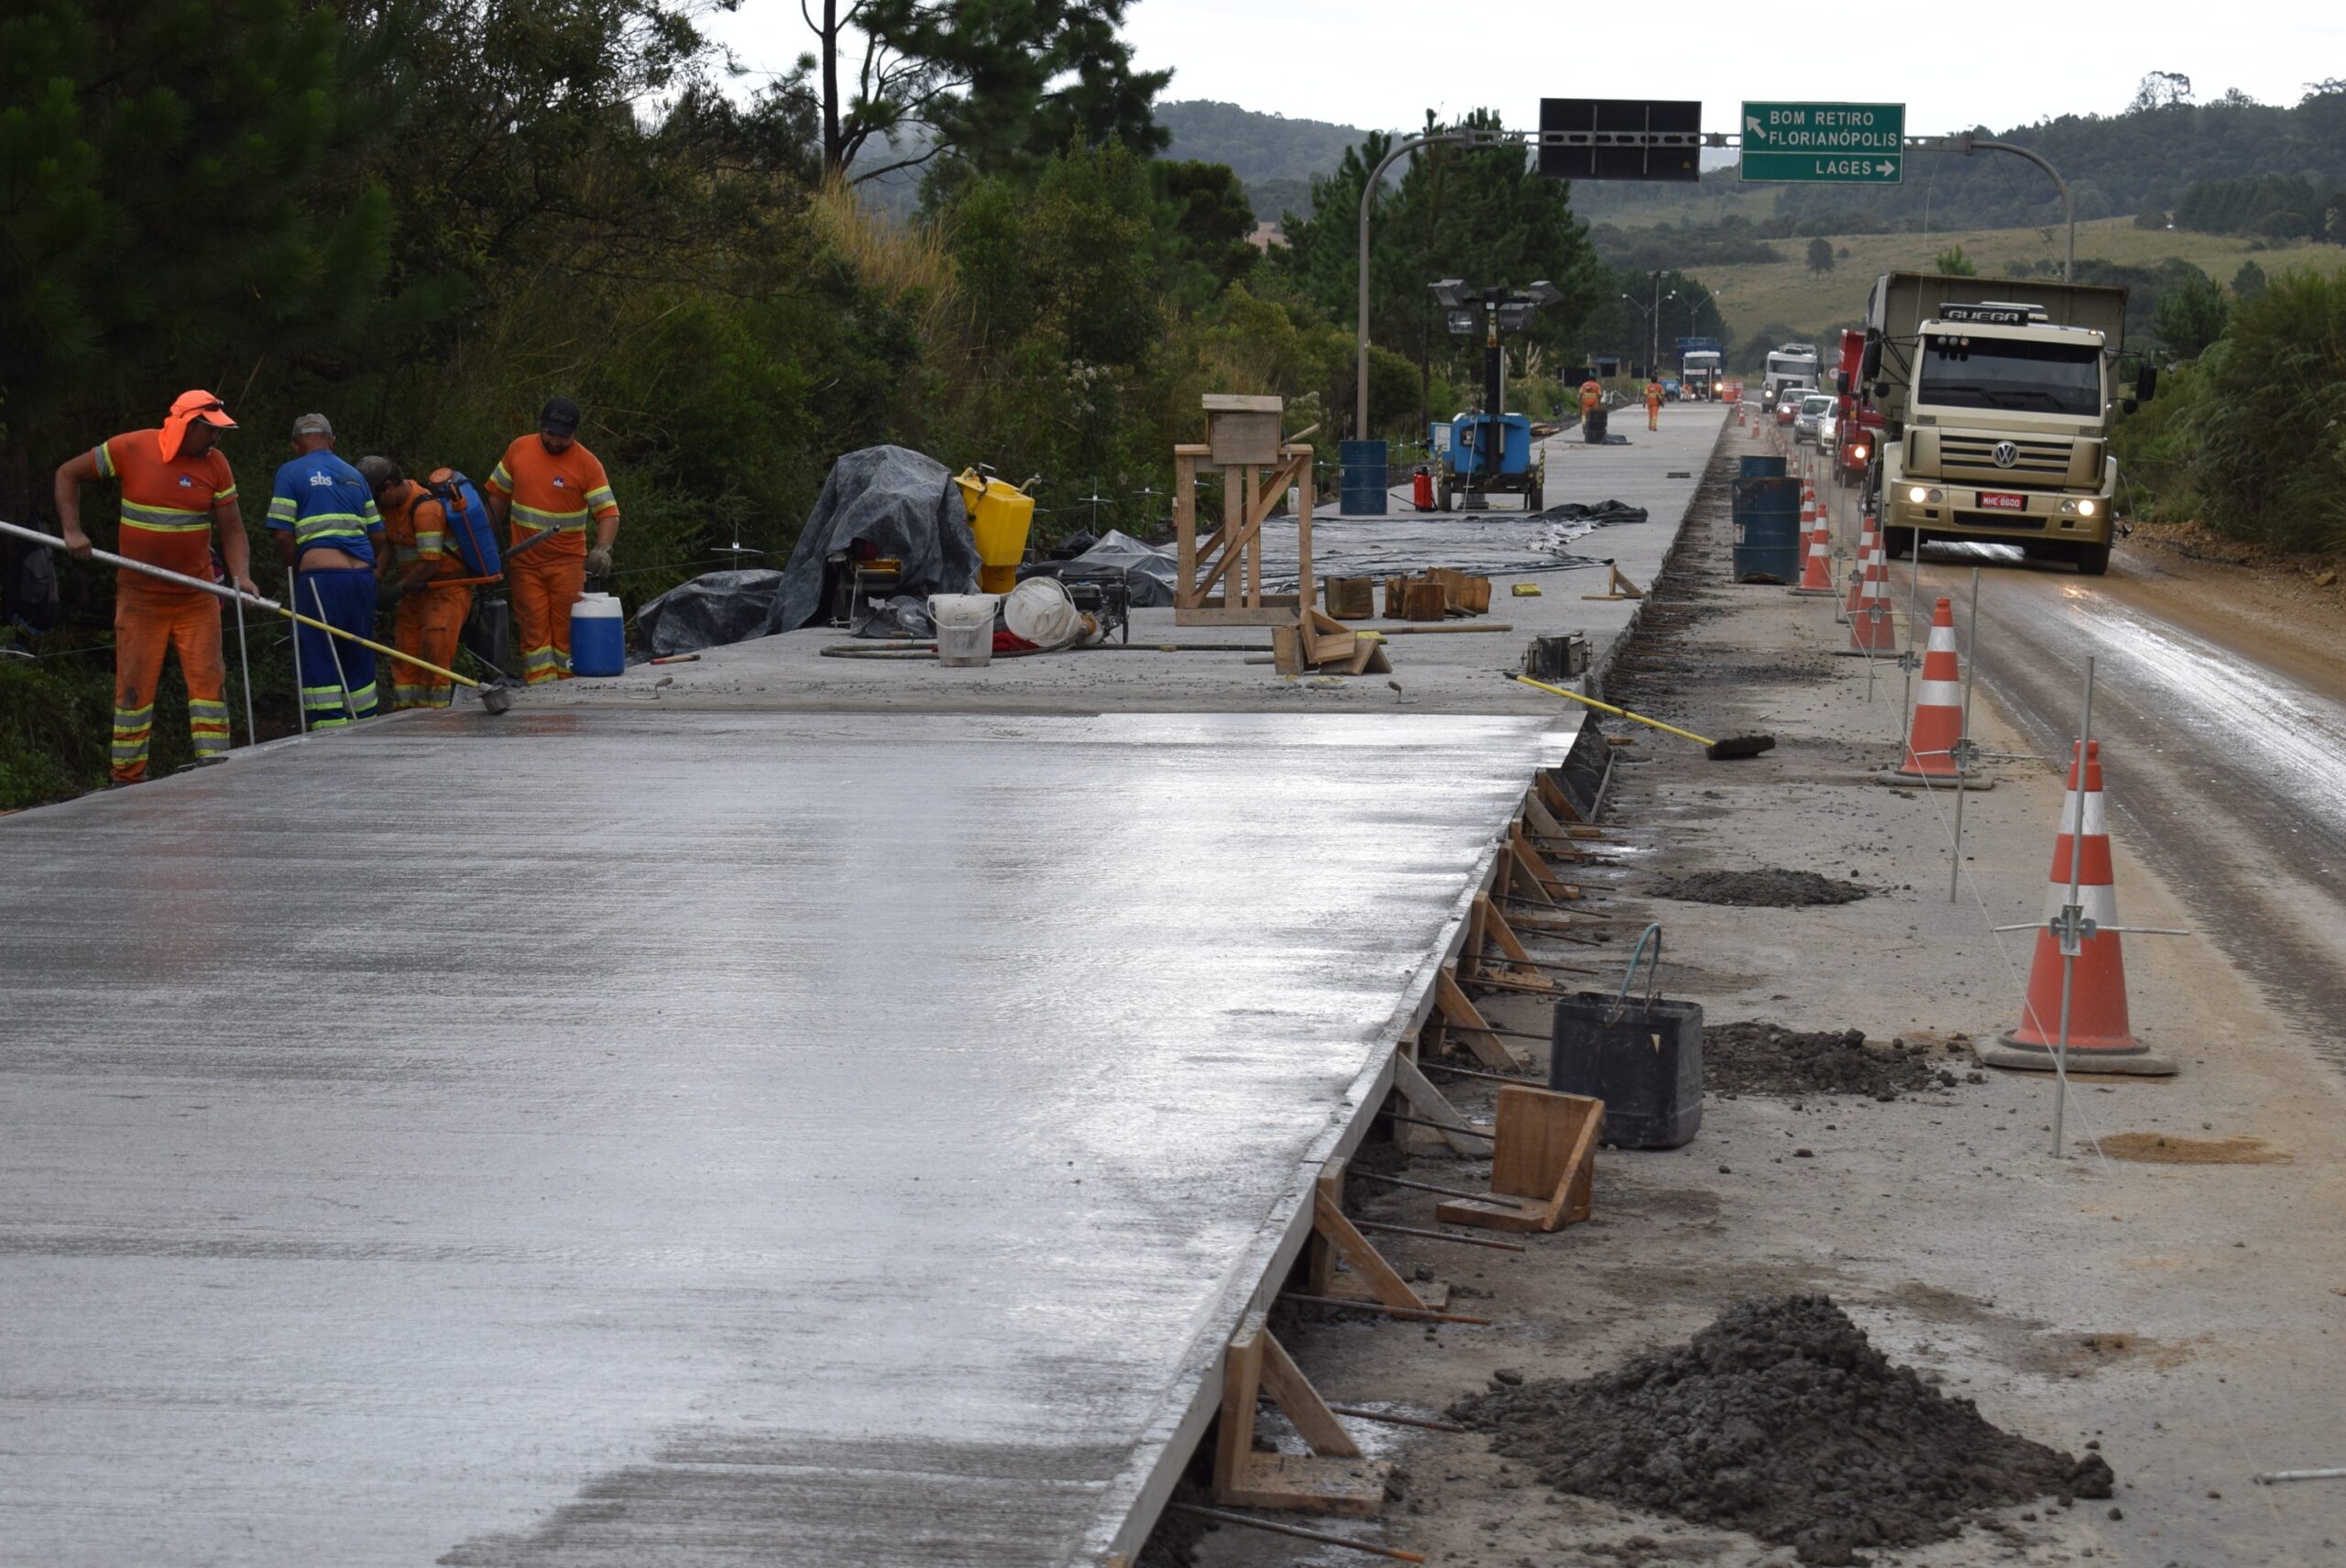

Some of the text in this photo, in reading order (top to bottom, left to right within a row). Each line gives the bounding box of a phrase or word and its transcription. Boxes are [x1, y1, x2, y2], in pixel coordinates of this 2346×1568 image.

[1770, 111, 1874, 126] BOM RETIRO
[1770, 128, 1897, 147] FLORIANÓPOLIS
[1816, 160, 1871, 175] LAGES
[310, 470, 333, 487] sbs
